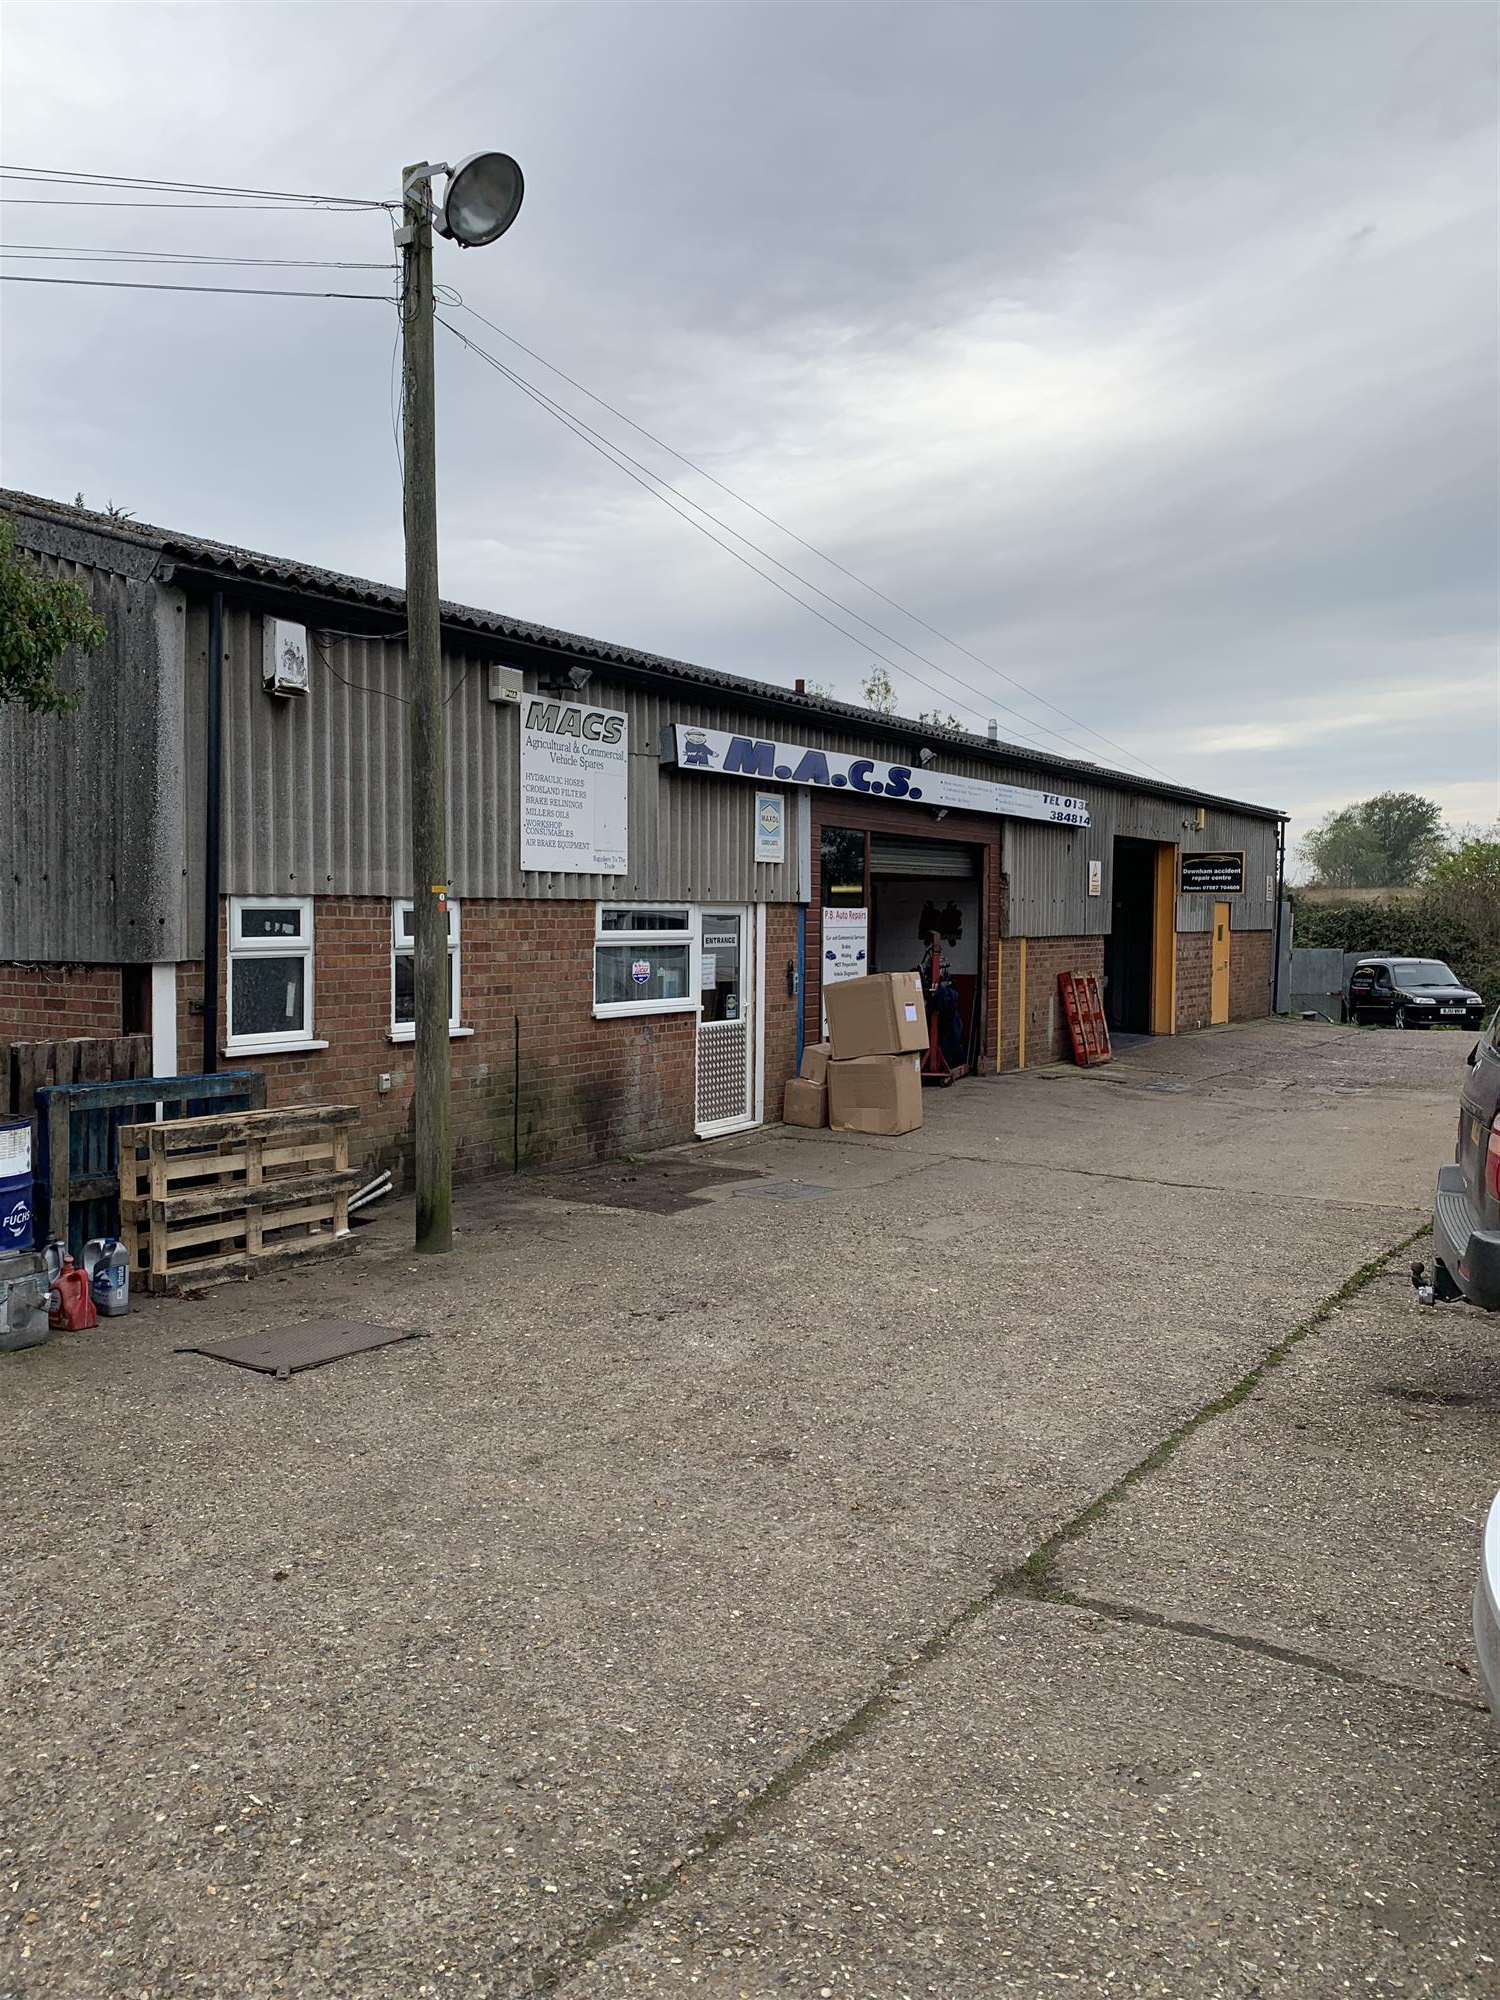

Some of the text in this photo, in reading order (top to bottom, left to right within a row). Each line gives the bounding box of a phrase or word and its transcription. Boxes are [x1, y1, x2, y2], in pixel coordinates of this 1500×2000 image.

[525, 700, 624, 744] MACS
[525, 736, 624, 762] Agricultural & Commercial
[550, 752, 604, 771] Vehicle Spares
[722, 737, 923, 800] M.A.C.S.
[525, 773, 585, 788] HYDRAULIC HOSES
[525, 784, 587, 799] CROSLAND FILTERS
[525, 796, 583, 809] BRAKE RELININGS
[1043, 794, 1060, 806] TEL
[525, 808, 570, 819] MILLERS OILS
[761, 814, 779, 824] MAXOL
[1049, 810, 1090, 826] 384814
[525, 819, 562, 829] WORKSHOP
[525, 827, 574, 838] CONSUMABLES
[525, 838, 590, 851] AIR BRAKE EQUIPMENT
[836, 910, 848, 920] Auto
[848, 911, 866, 920] Repairs
[705, 936, 736, 945] ENTRANCE
[2, 1211, 30, 1227] FUCHS
